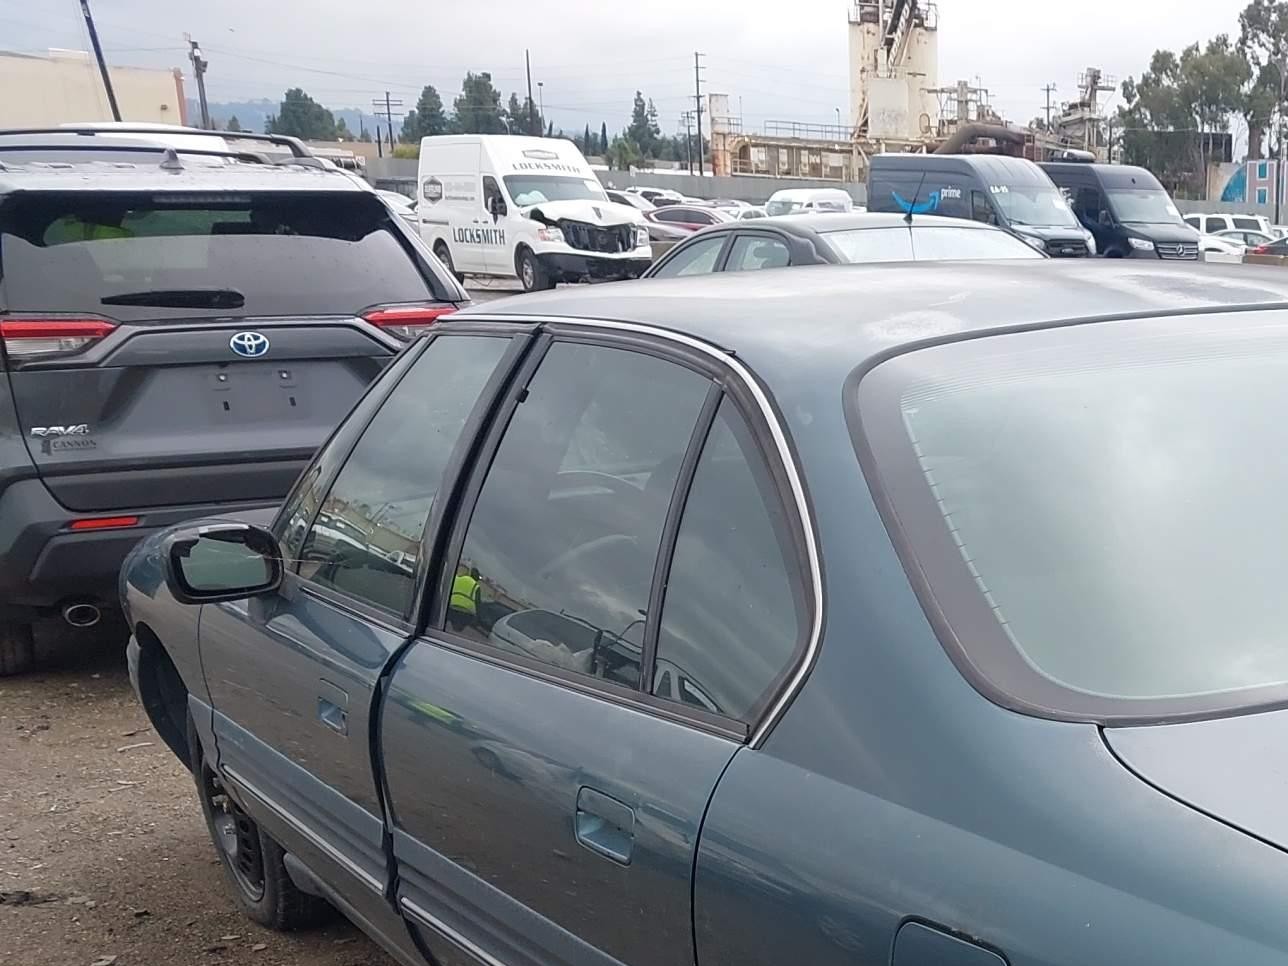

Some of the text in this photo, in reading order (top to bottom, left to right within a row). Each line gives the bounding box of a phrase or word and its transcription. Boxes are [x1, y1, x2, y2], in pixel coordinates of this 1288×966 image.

[512, 162, 581, 174] LOCKSMITH
[940, 186, 961, 200] prime
[453, 227, 506, 246] LOCKSMITH
[31, 424, 90, 437] RAV4
